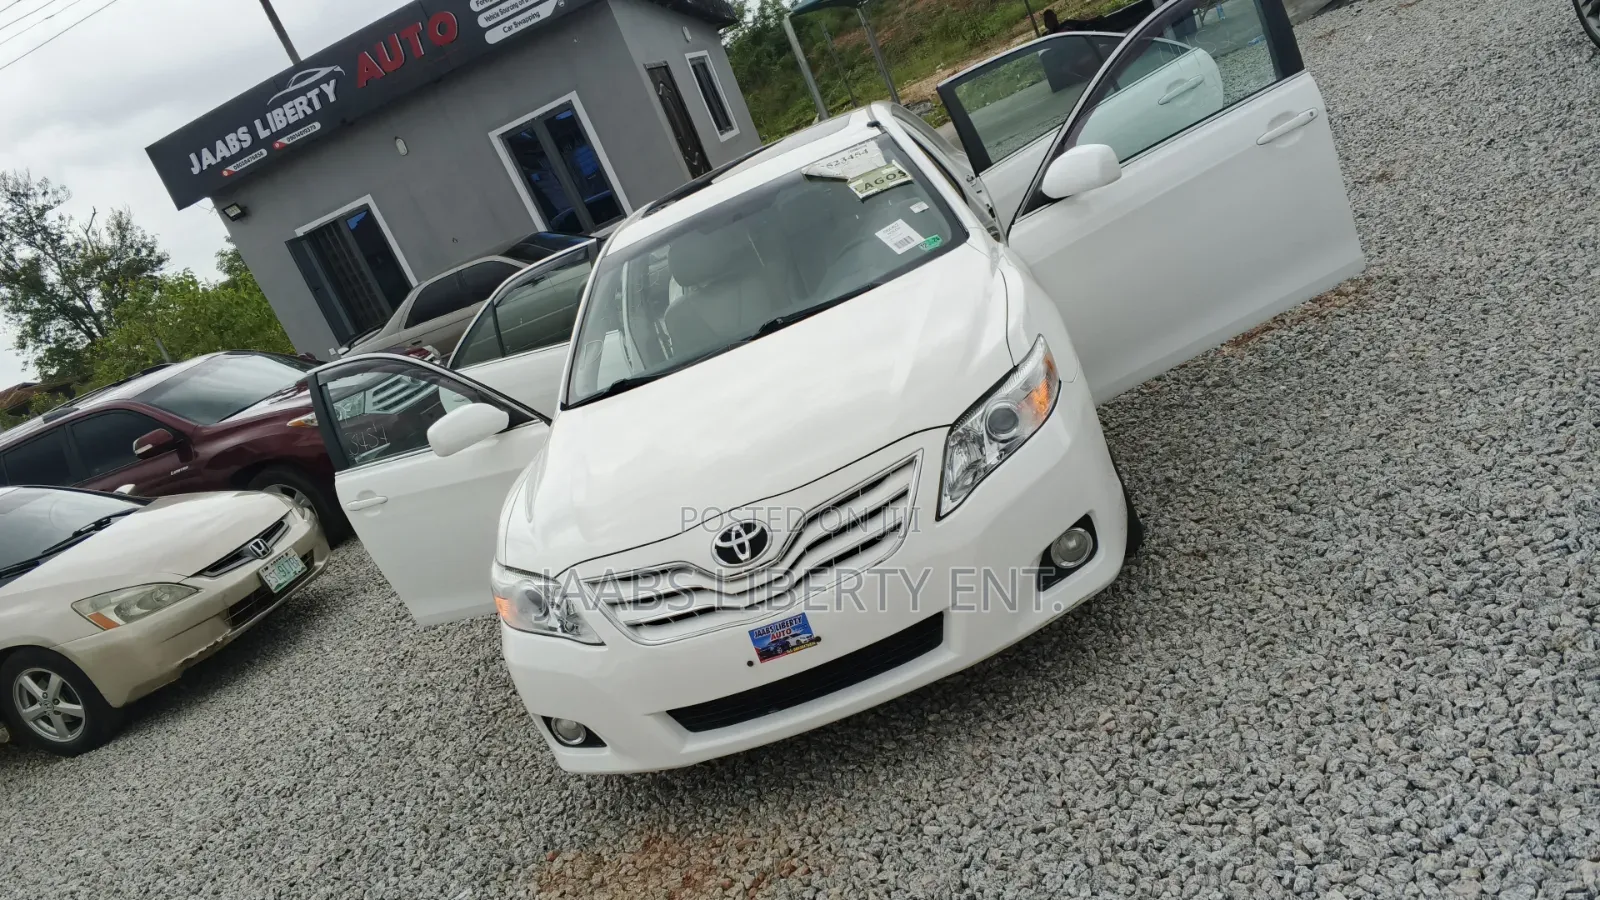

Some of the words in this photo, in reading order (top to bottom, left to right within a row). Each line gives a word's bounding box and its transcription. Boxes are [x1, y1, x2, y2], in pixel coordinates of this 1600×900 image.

[483, 10, 500, 22] Vehicle
[498, 2, 519, 15] Sourcing
[502, 24, 513, 33] Car
[513, 11, 541, 26] Swapping
[356, 10, 459, 89] AUTO
[188, 125, 253, 175] JAABS
[253, 78, 337, 140] LIBERTY
[754, 626, 774, 638] JAABS
[775, 616, 802, 632] LIBERTY
[770, 628, 792, 641] AUTO
